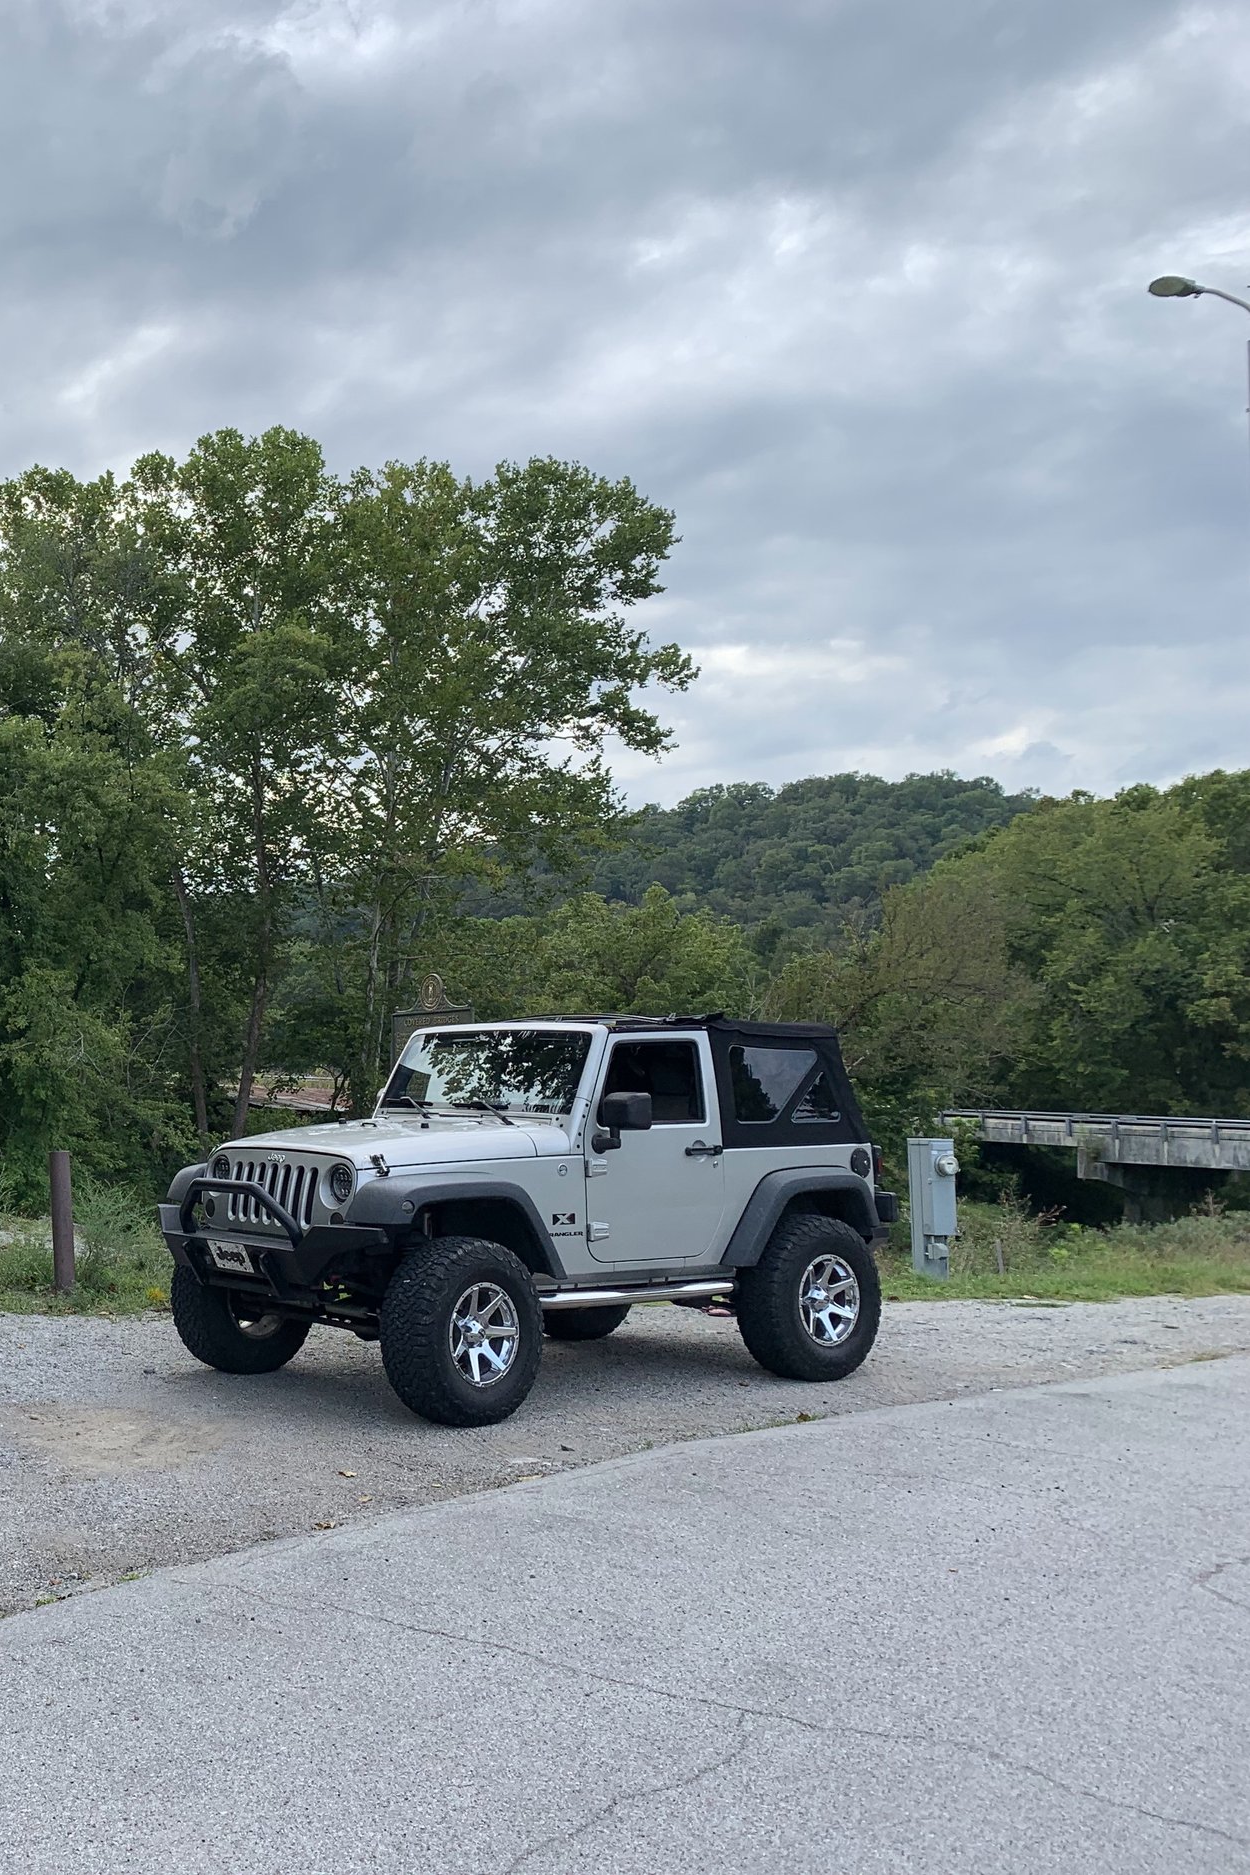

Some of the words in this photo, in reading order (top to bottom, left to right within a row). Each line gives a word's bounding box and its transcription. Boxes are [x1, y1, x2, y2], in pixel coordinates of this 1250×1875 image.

[404, 1017, 431, 1026] COVERED
[267, 1152, 286, 1163] Jeep
[216, 1246, 246, 1267] Jeep
